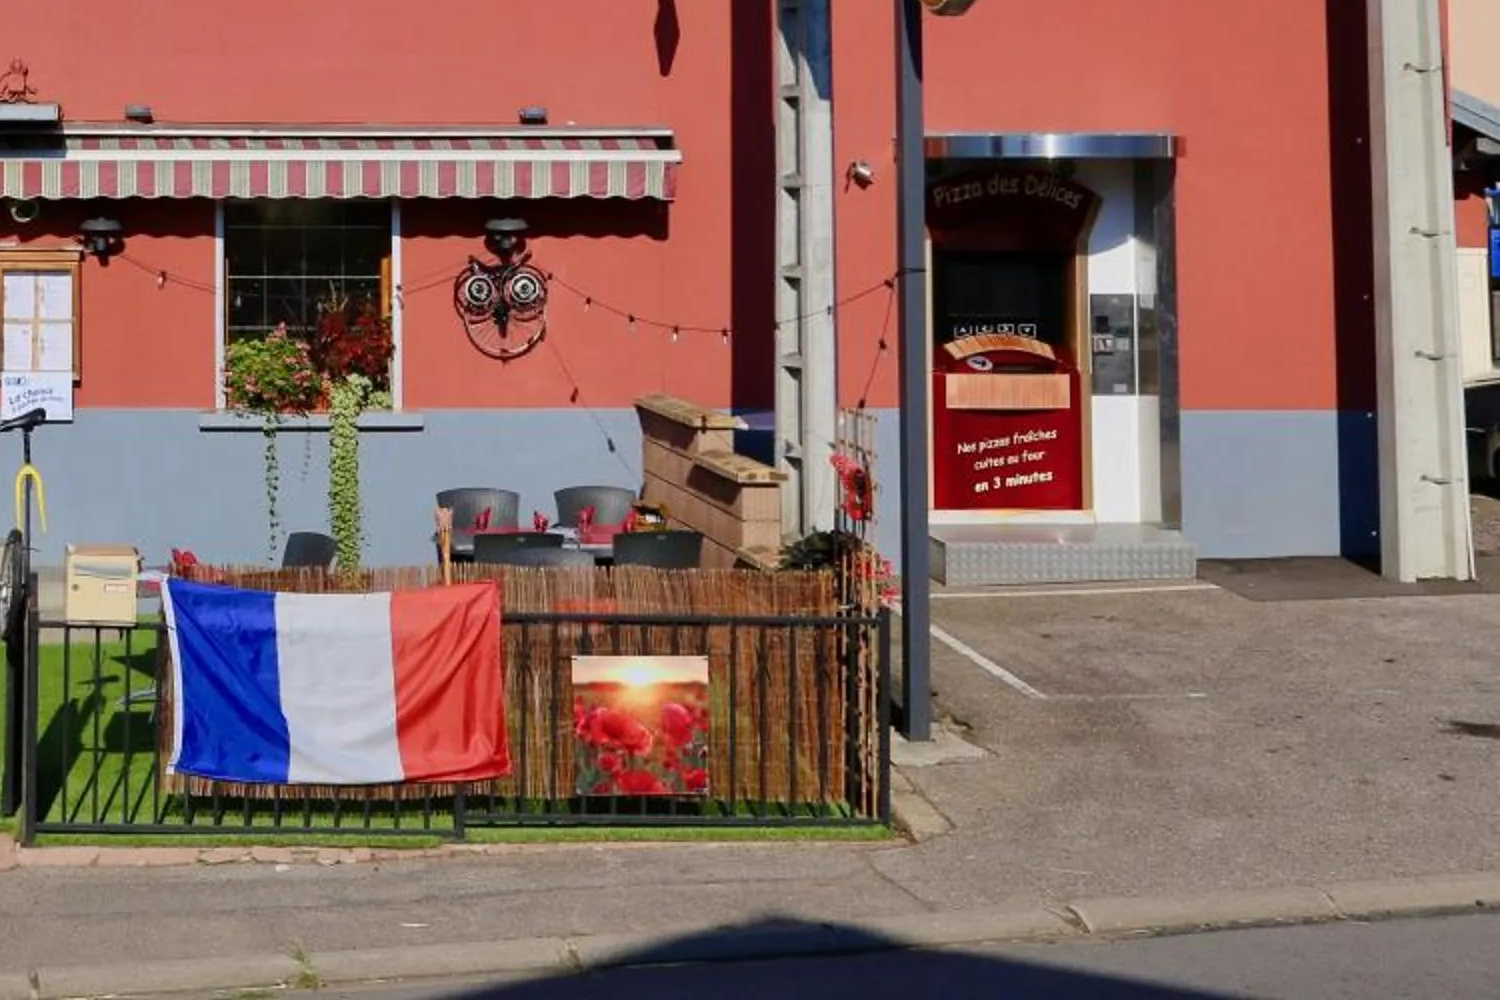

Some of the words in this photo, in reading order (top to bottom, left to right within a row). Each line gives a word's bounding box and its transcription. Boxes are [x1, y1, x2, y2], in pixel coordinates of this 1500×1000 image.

[932, 183, 982, 208] Pizza
[987, 173, 1020, 195] des
[957, 442, 977, 455] Nos
[978, 436, 1011, 453] pizzas
[974, 481, 989, 493] en
[993, 476, 1001, 489] 3
[1005, 471, 1053, 487] minutes
